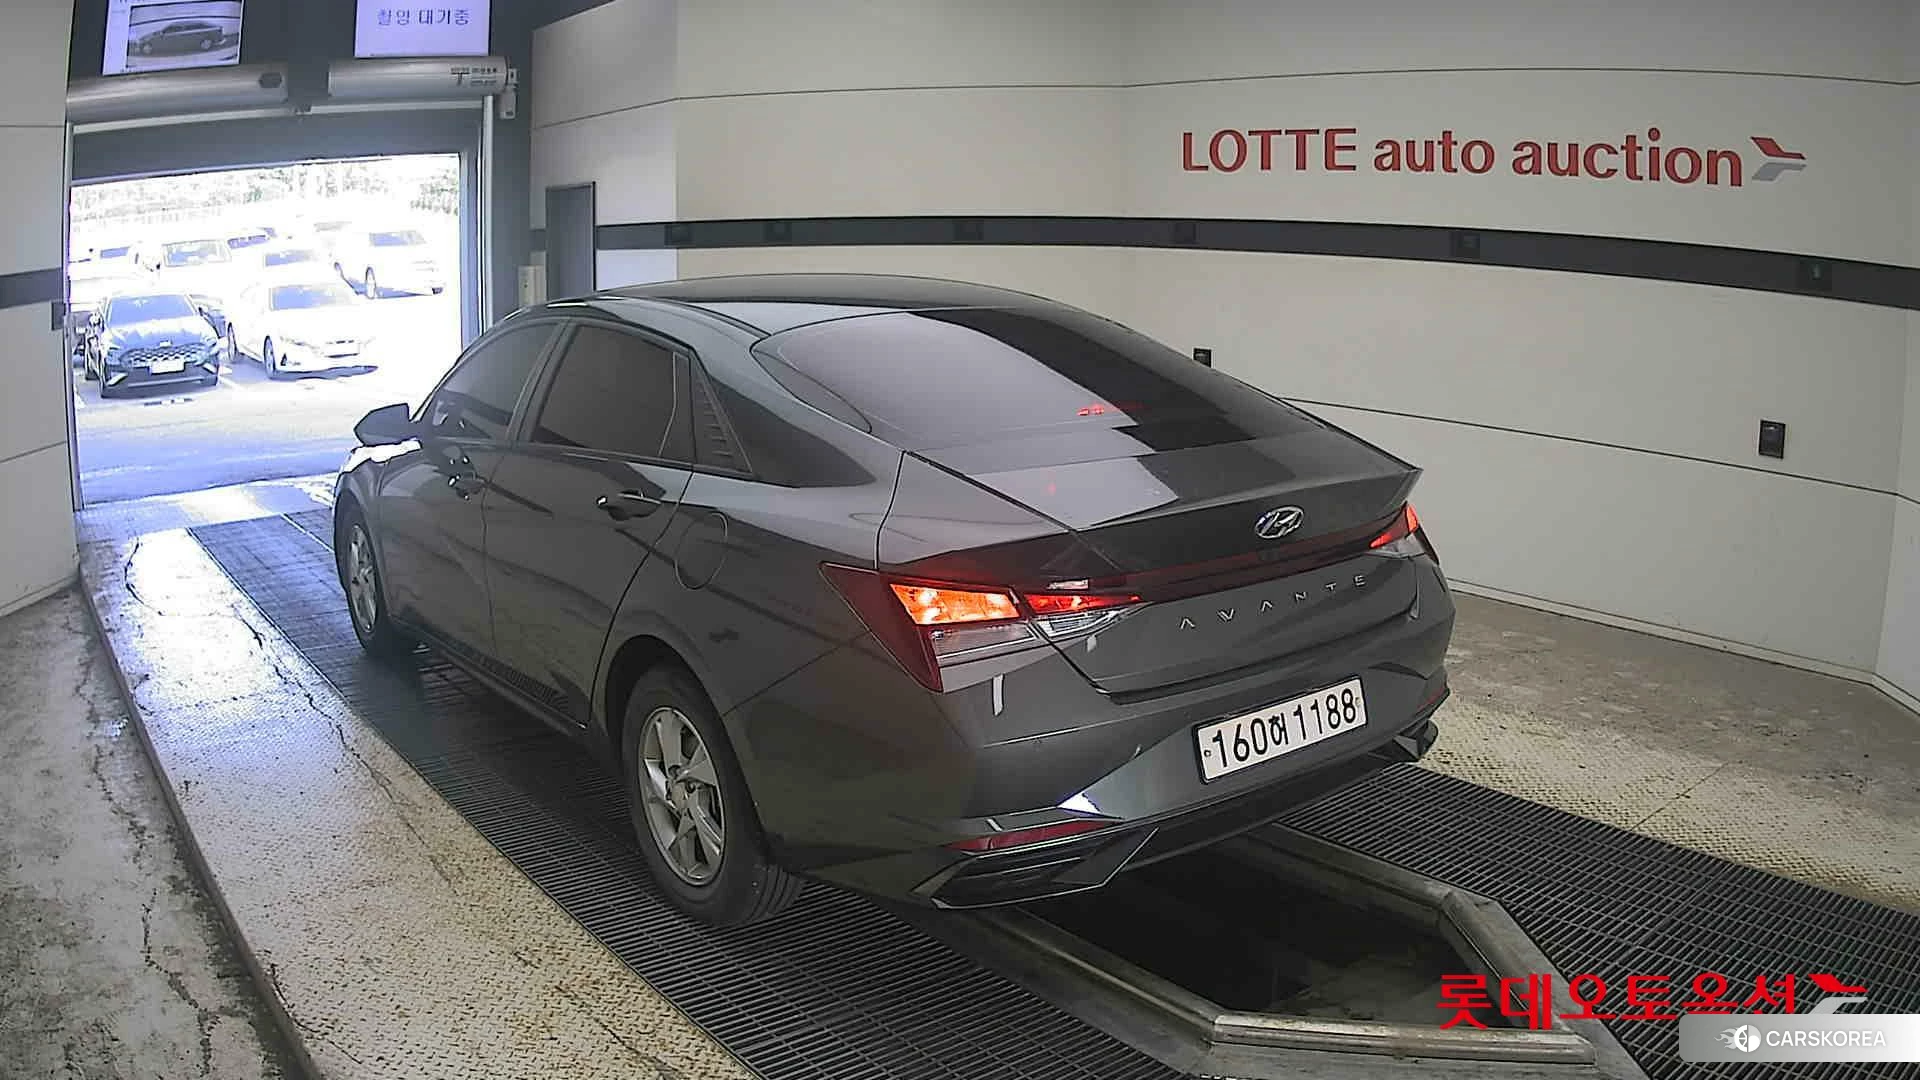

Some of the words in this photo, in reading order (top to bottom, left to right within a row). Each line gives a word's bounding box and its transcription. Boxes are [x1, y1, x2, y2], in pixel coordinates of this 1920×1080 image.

[1182, 127, 1358, 173] LOTTE
[1373, 130, 1496, 174] auto
[1511, 127, 1743, 187] auction
[1179, 574, 1367, 630] AVANTE
